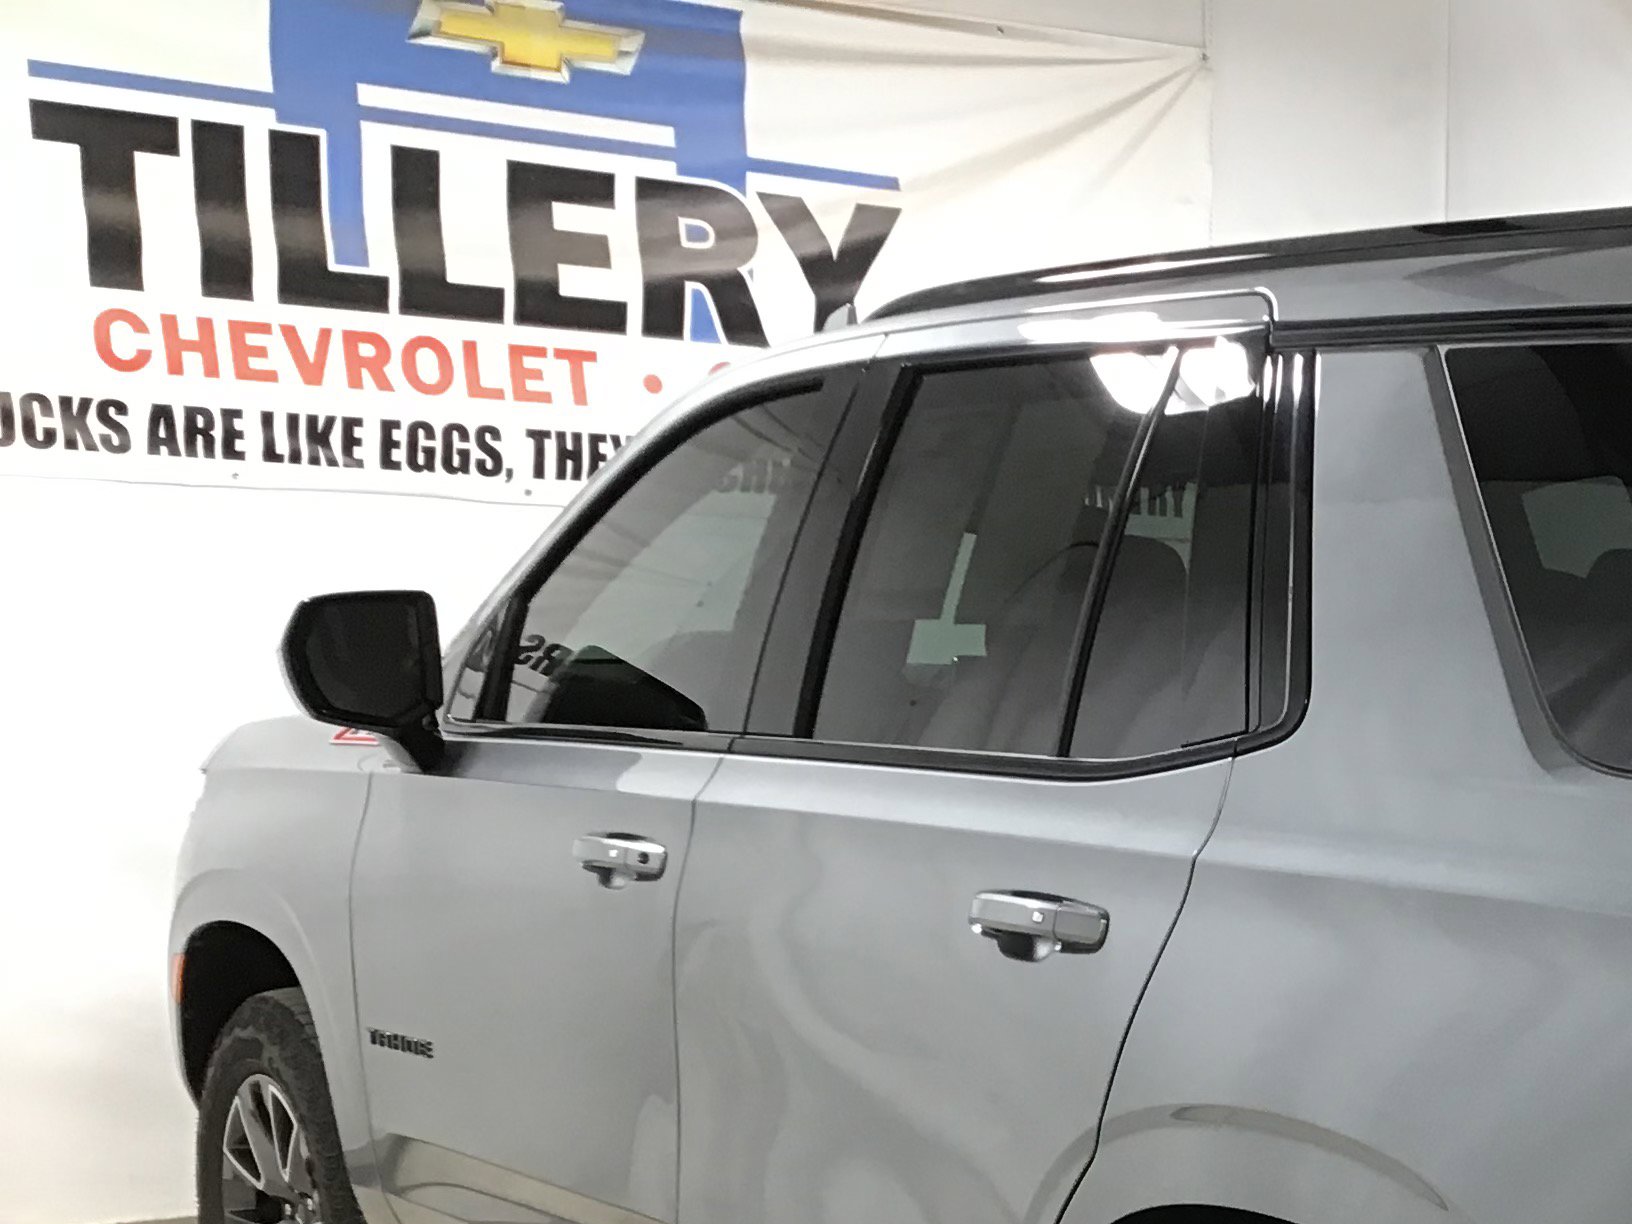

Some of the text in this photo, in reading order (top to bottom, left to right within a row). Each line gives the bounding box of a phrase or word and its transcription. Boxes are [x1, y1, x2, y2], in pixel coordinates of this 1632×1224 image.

[29, 98, 902, 348] TILLERY
[93, 308, 599, 407] CHEVROLET
[147, 403, 246, 461] ARE
[260, 410, 365, 469] LIKE
[379, 418, 514, 483] EGGS,
[366, 1027, 434, 1059] TAHOE
